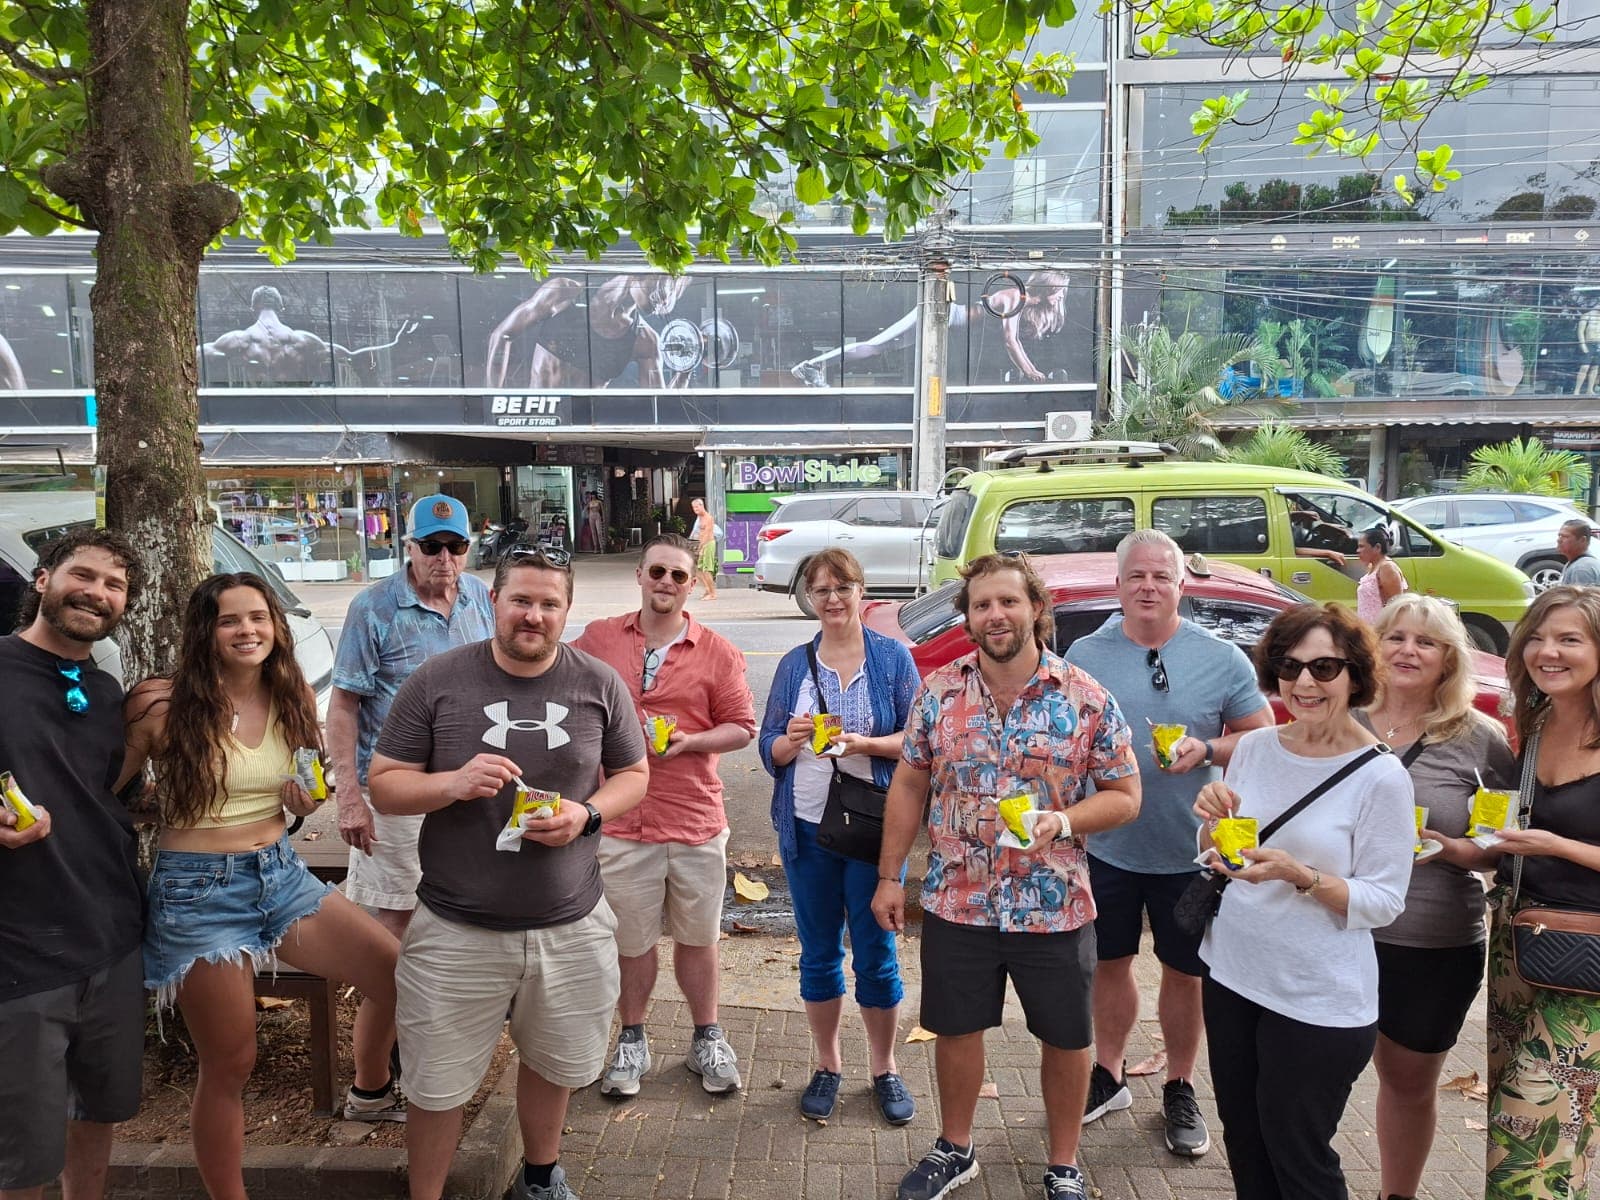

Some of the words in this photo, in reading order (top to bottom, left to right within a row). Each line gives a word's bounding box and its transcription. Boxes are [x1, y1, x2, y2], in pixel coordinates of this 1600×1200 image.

[491, 396, 522, 414] BE
[524, 396, 561, 414] FIT
[497, 418, 527, 426] SPORT
[528, 418, 557, 426] STORE
[740, 459, 882, 485] BowlShake
